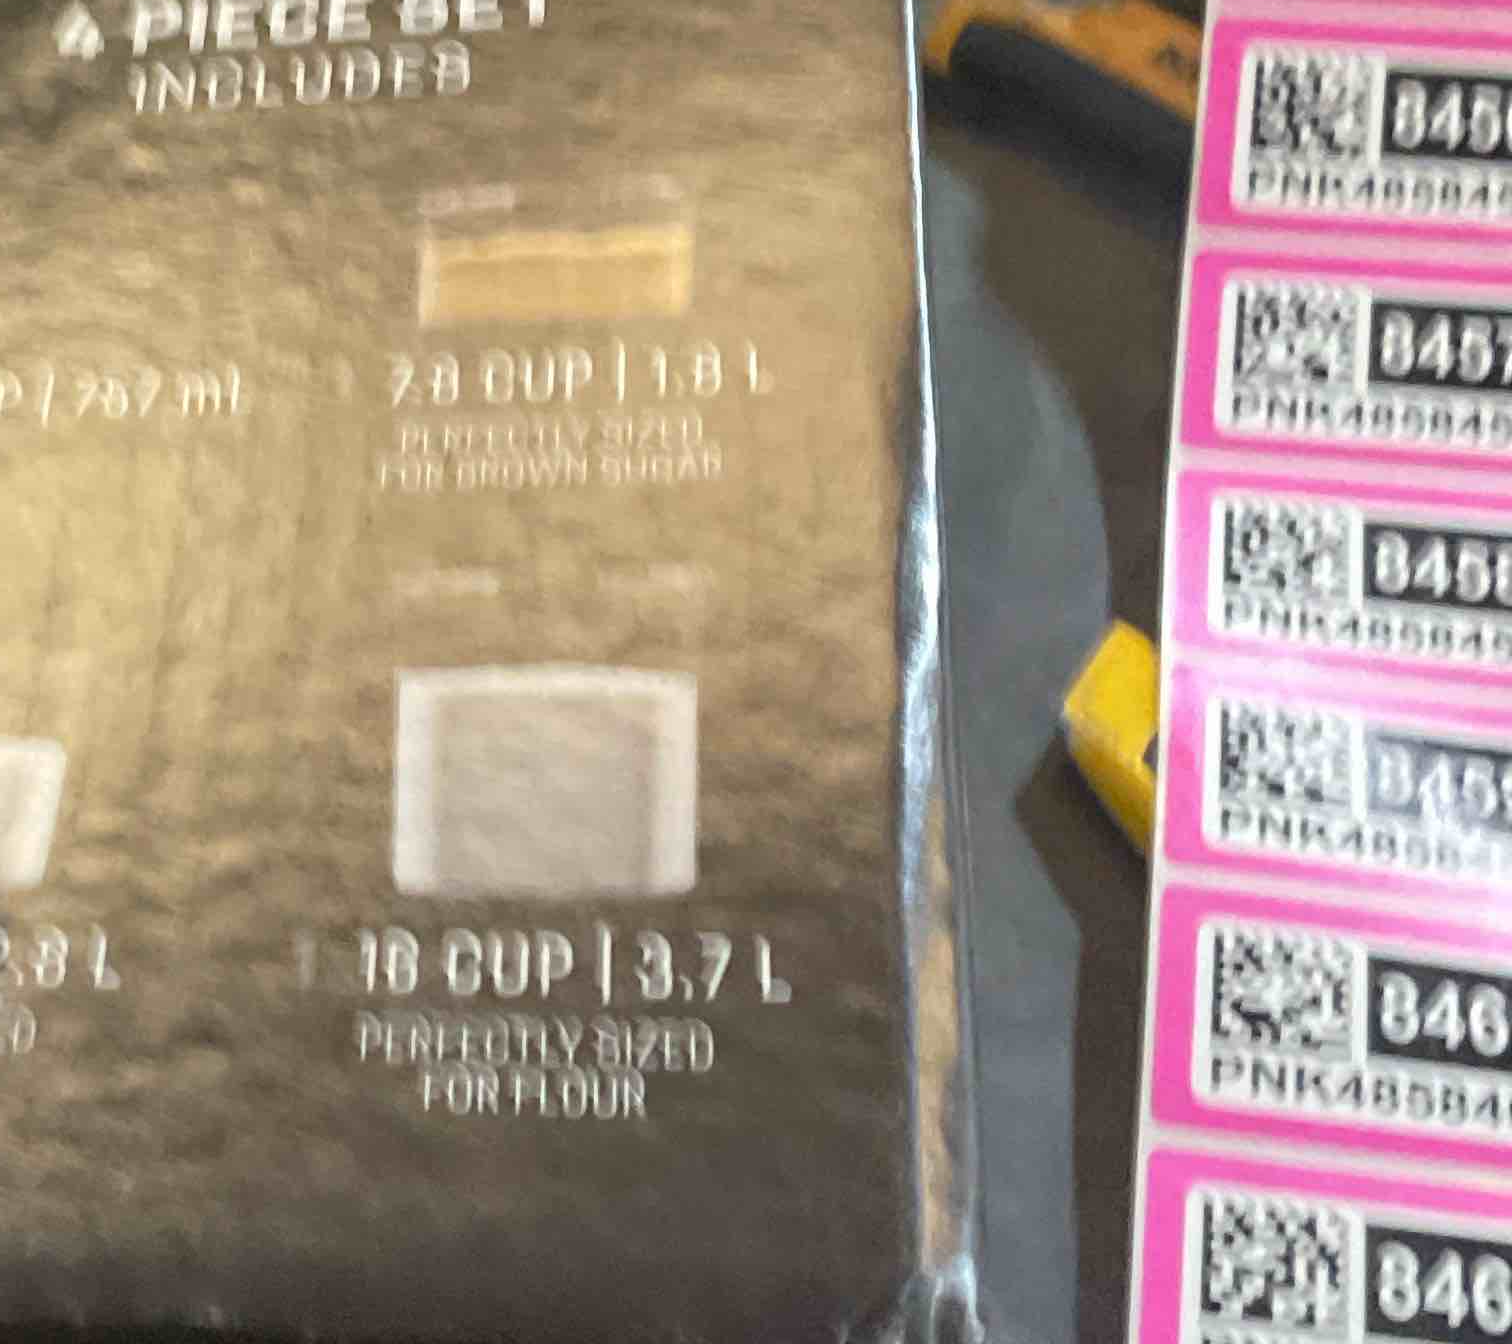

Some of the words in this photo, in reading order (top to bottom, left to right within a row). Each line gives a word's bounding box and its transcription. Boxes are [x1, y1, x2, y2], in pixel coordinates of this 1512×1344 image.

[129, 39, 472, 114] INCLUDES
[484, 345, 594, 404] CUP
[442, 927, 574, 1000] CUP
[356, 1008, 584, 1070] PERFECTLY
[592, 1013, 715, 1073] SIZED
[422, 1061, 499, 1116] FOR
[512, 1062, 647, 1120] FLOUR
